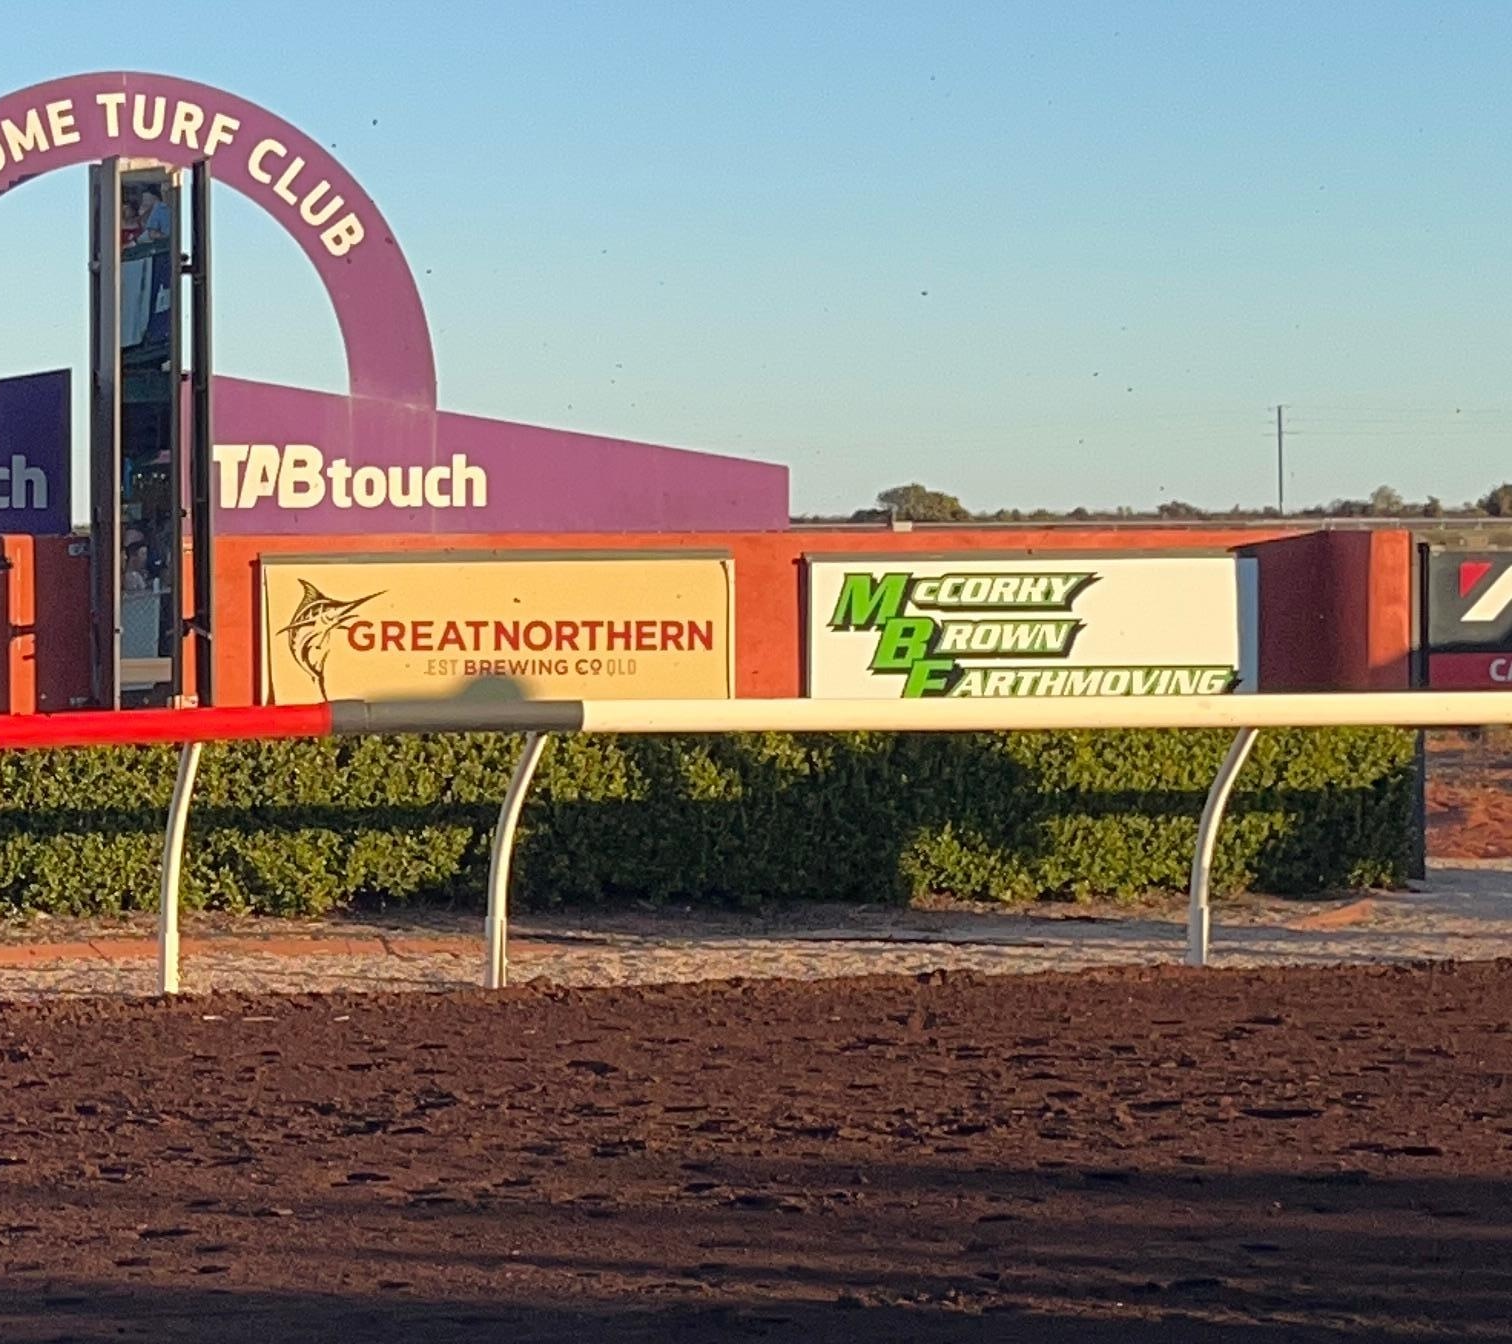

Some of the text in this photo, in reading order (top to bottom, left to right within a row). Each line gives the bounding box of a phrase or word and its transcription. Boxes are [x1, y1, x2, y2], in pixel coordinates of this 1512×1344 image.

[96, 93, 241, 157] TURF
[248, 138, 366, 257] CLUB
[425, 659, 459, 676] EST
[464, 659, 569, 676] BREWING
[606, 659, 638, 677] QLD
[869, 617, 1070, 669] BROWN
